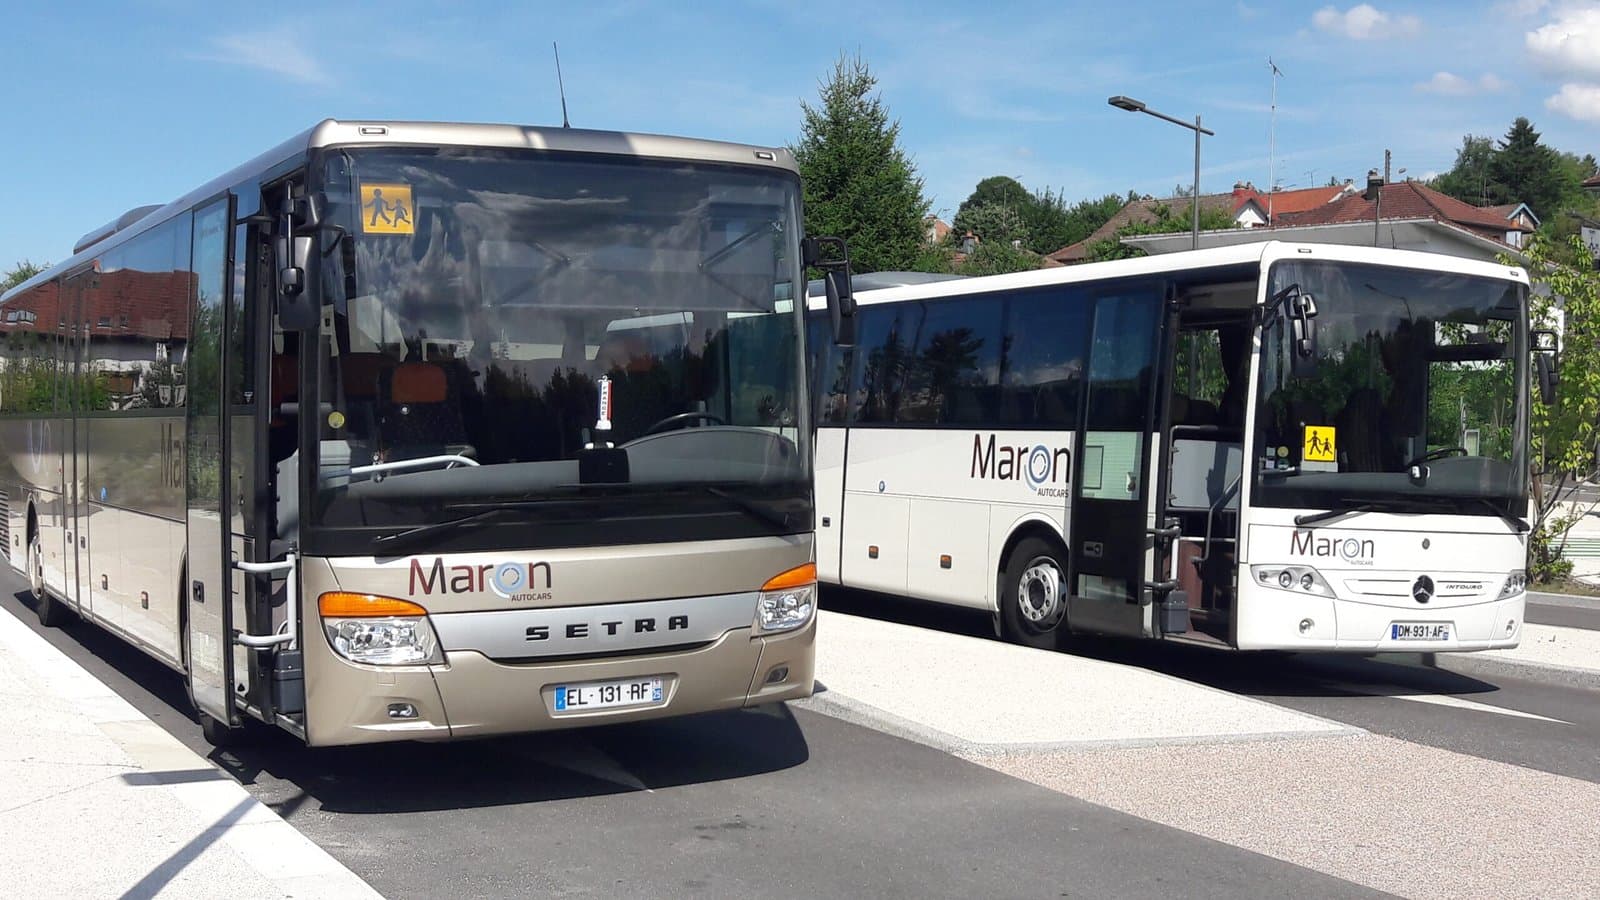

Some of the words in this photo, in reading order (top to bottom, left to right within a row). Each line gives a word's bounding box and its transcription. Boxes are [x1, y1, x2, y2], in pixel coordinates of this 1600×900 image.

[970, 433, 1071, 483] Maron
[1037, 487, 1069, 498] AUTOCARS
[1290, 530, 1374, 558] Maron
[409, 557, 551, 596] Maron
[511, 592, 552, 601] AUTOCARS
[525, 615, 689, 641] SETRA
[1398, 625, 1443, 637] DM-931-AF
